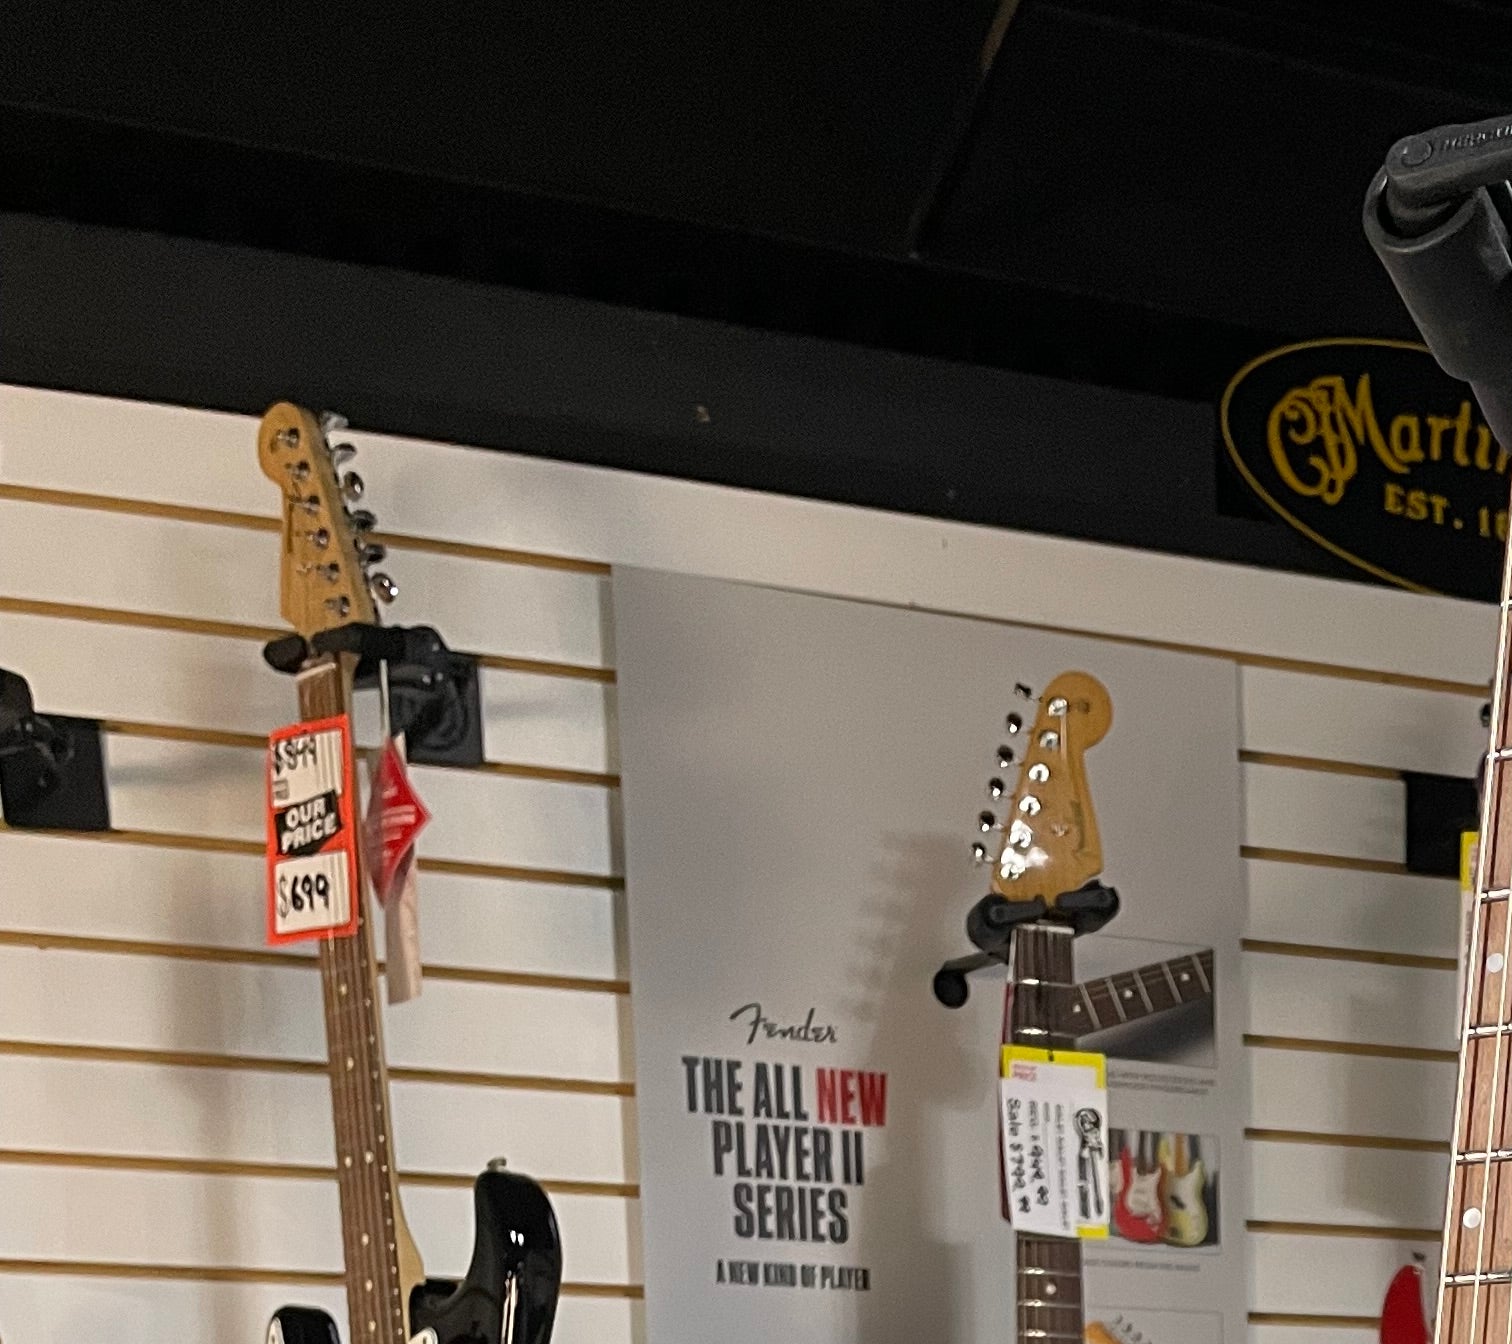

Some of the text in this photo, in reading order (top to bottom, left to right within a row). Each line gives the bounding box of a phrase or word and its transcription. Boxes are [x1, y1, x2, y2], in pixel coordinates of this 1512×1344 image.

[281, 812, 338, 854] PRICE
[285, 797, 327, 829] OUR
[278, 873, 330, 919] $699
[729, 1002, 840, 1045] Fender
[681, 1055, 888, 1128] THE ALL NEW
[712, 1119, 865, 1186] PLAYER II
[733, 1182, 849, 1245] SERIES
[716, 1258, 727, 1284] A
[729, 1260, 760, 1287] NEW
[820, 1265, 872, 1292] PLAYER
